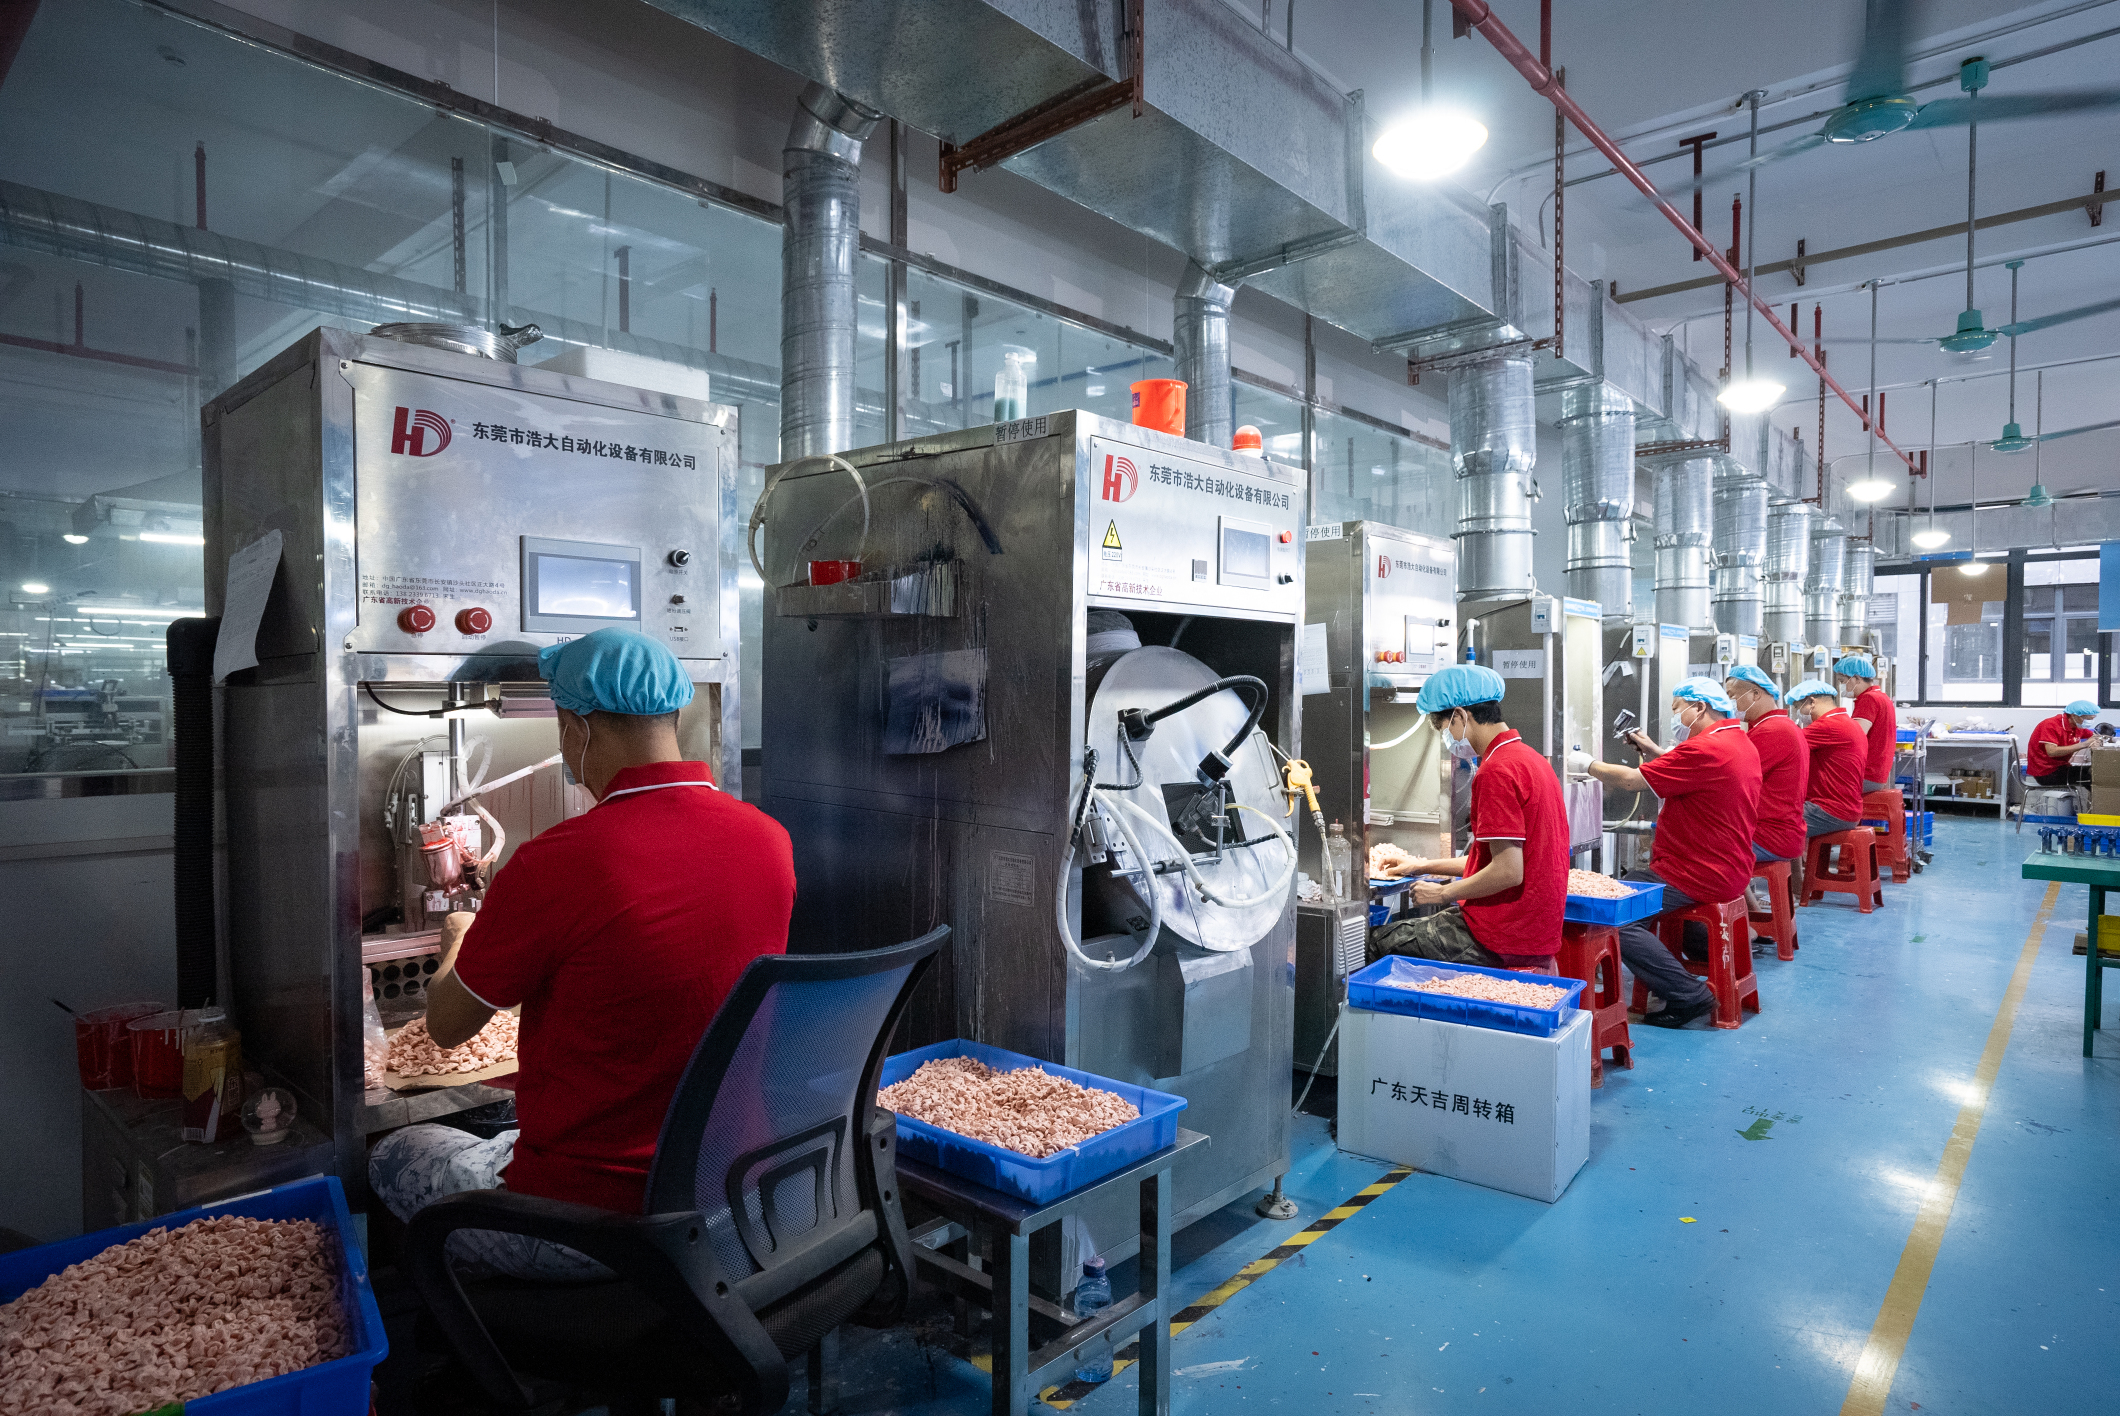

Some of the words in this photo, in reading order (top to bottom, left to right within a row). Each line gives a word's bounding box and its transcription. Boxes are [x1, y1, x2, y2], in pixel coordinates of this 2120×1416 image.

[472, 421, 696, 470] 东莞市浩大自动化设备有限公司
[995, 416, 1047, 442] 暂停使用
[1149, 463, 1289, 510] 东莞市浩大自动化设备有限公司
[1100, 580, 1163, 596] 广东省高新技术企业
[1502, 660, 1537, 670] 暂停使用
[1370, 1077, 1515, 1125] 广东天吉周转箱
